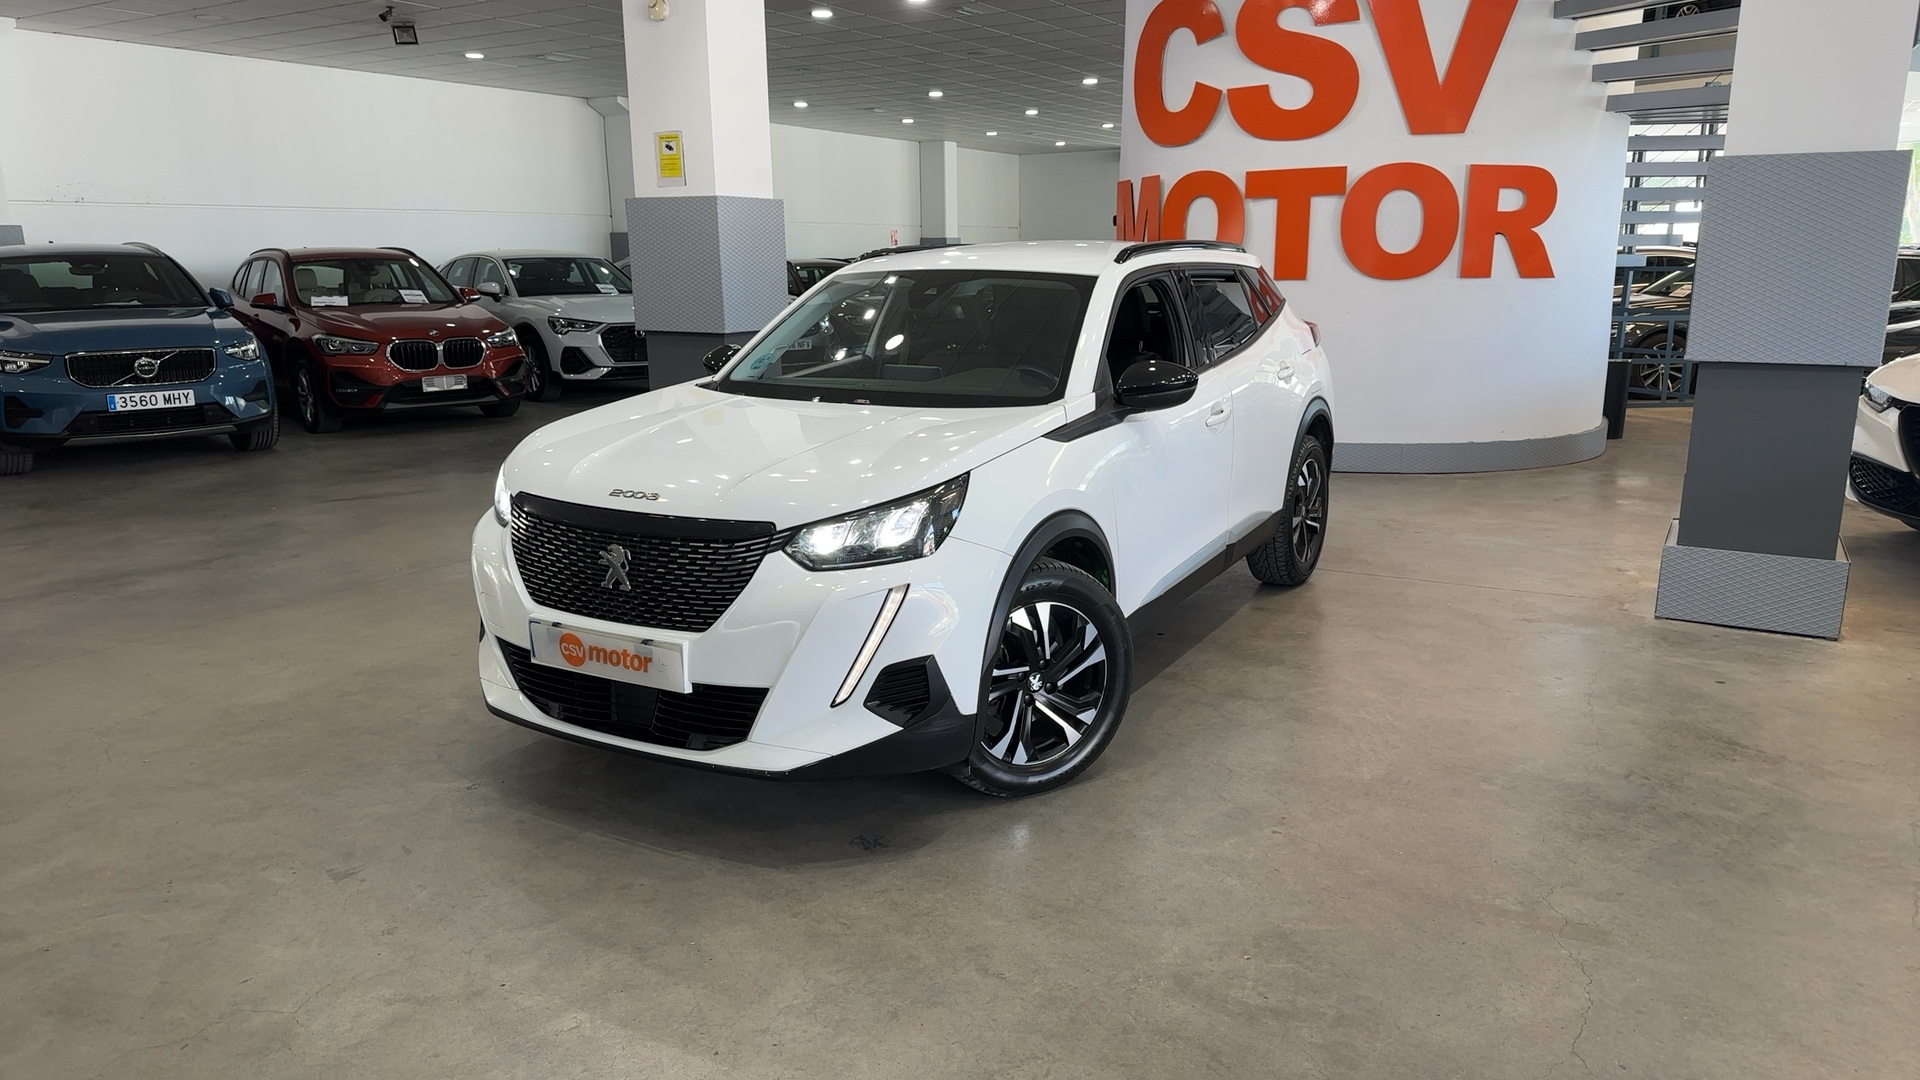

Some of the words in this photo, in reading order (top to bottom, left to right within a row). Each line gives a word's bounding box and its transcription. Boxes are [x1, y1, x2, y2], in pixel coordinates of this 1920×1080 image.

[1134, 0, 1518, 147] CSV
[1117, 162, 1558, 281] MOTOR
[119, 394, 158, 408] 3560
[162, 391, 190, 406] MHY
[608, 488, 660, 501] 2008
[588, 644, 653, 673] motor
